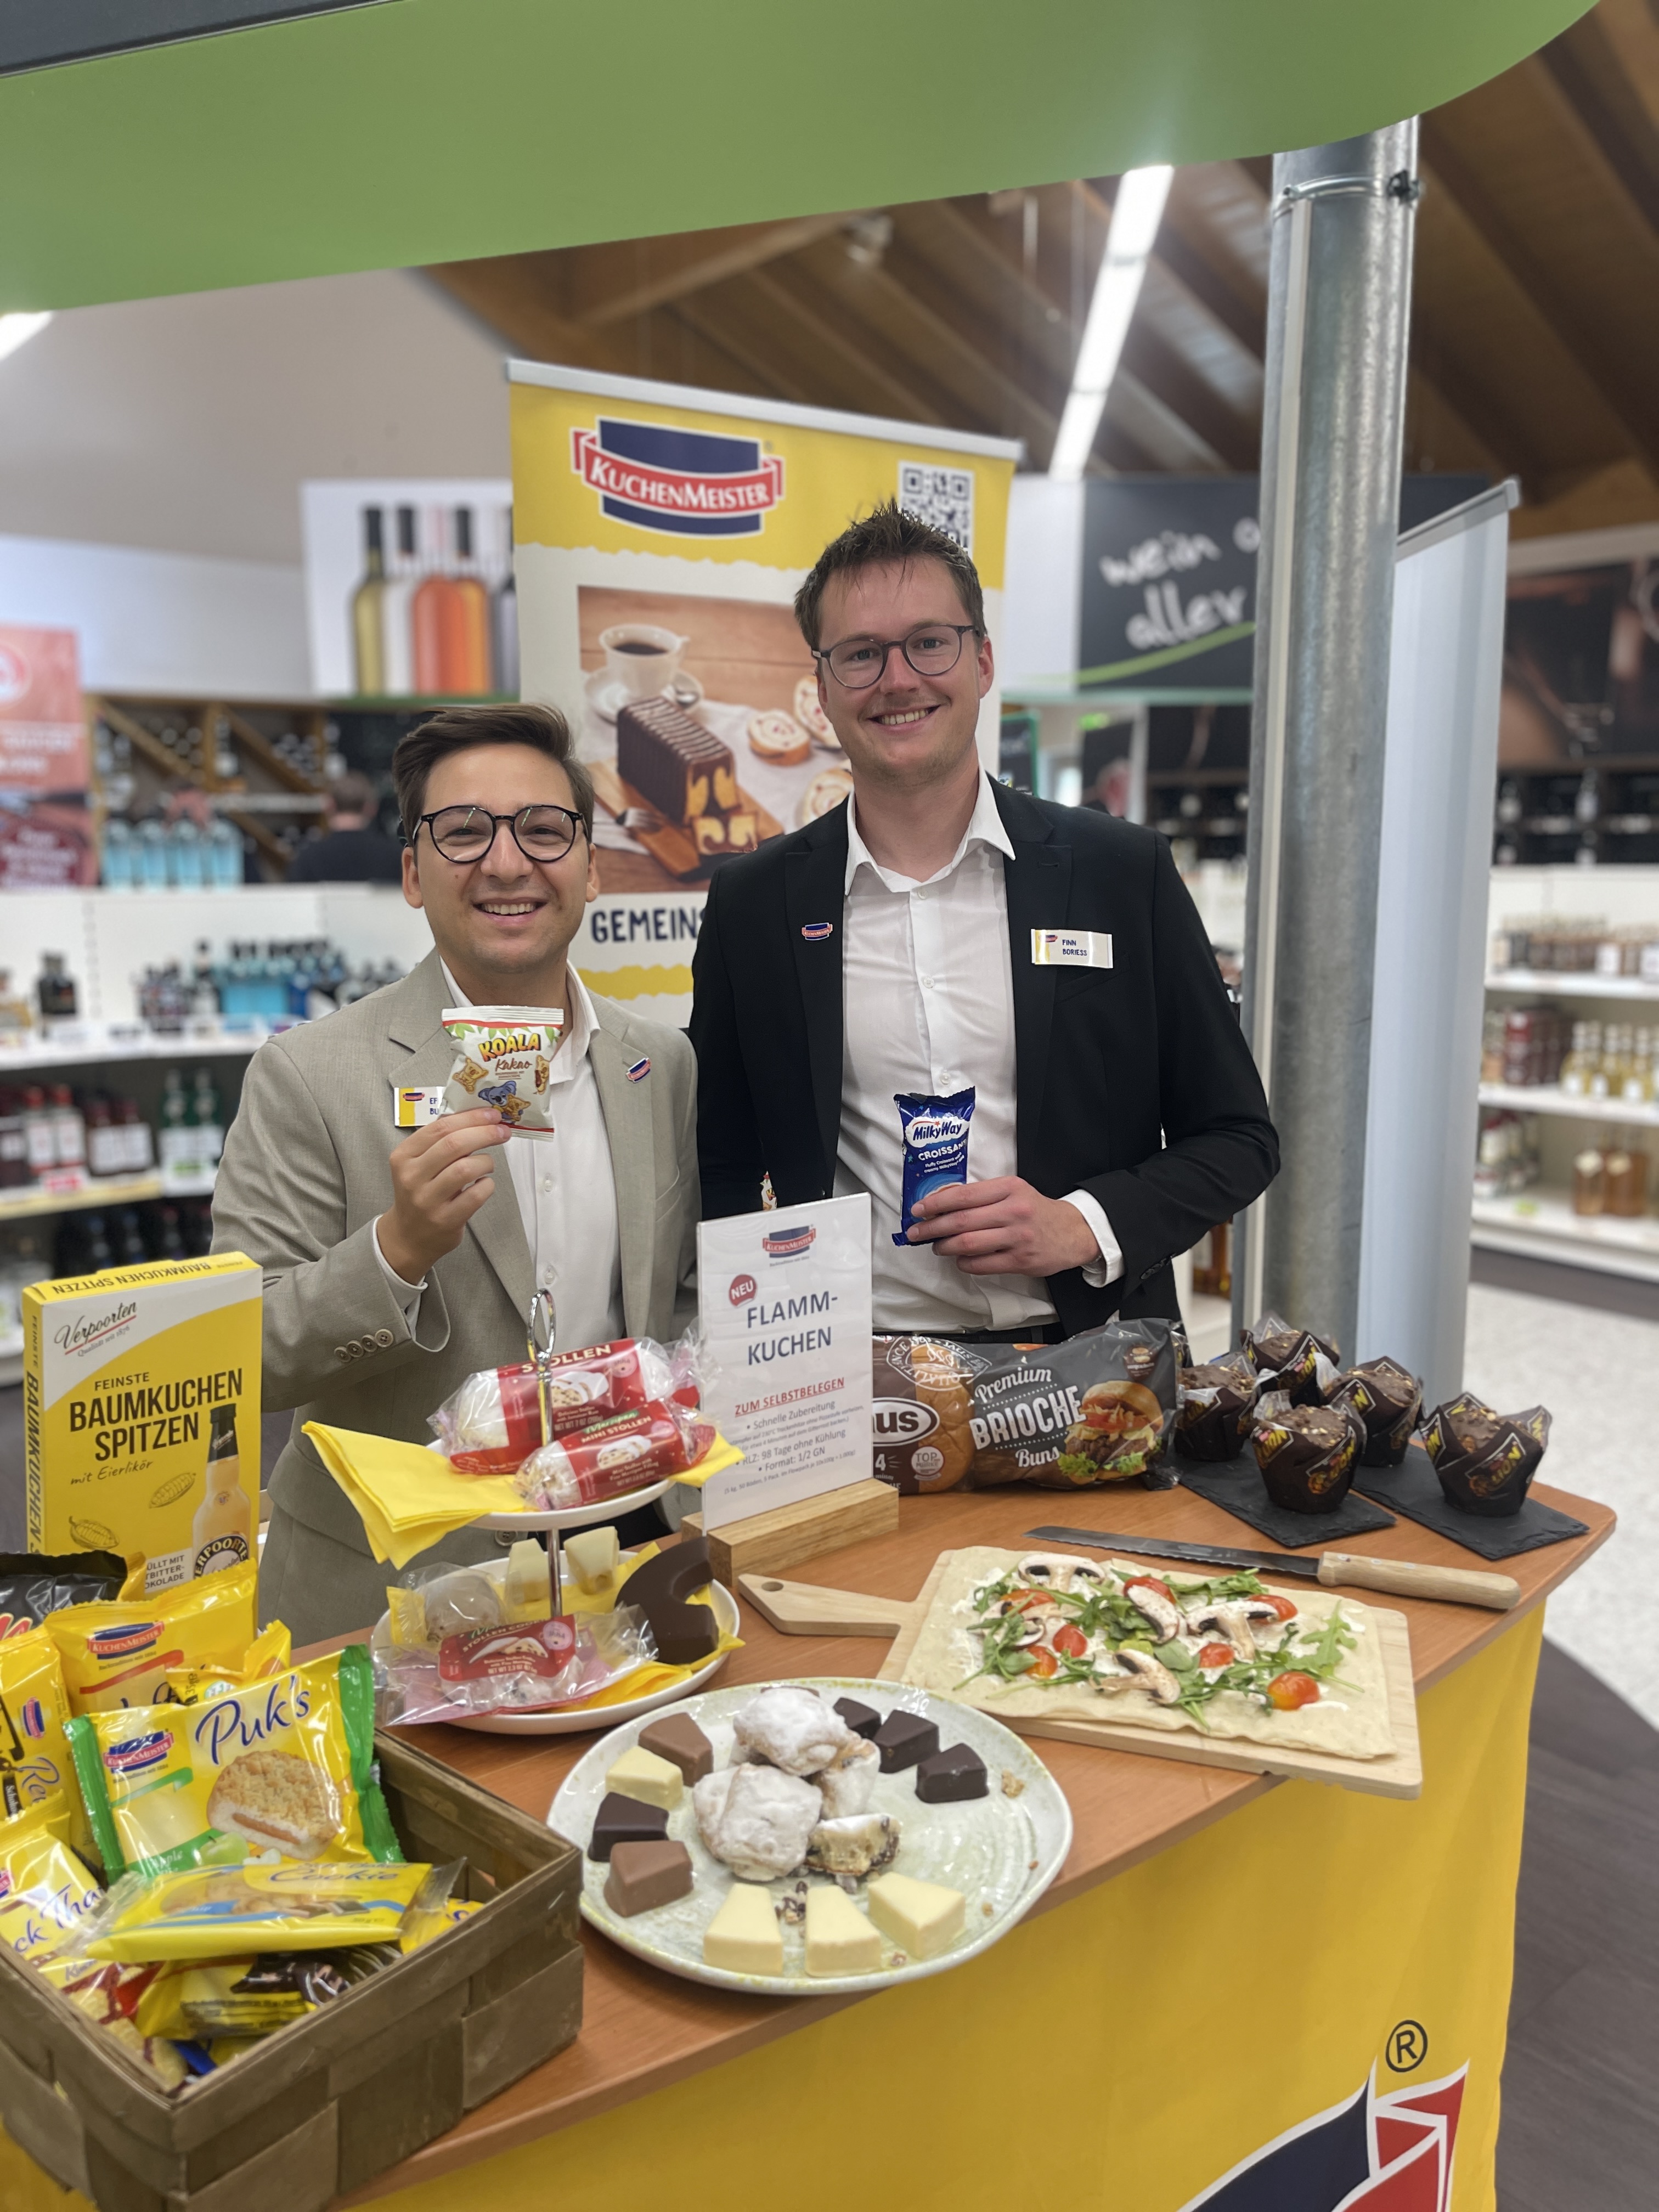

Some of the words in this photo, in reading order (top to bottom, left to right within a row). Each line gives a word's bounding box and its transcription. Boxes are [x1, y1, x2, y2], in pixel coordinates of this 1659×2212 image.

[1062, 948, 1087, 956] BORIESS
[478, 1033, 541, 1062] KOALA
[495, 1058, 533, 1072] Kakao
[52, 1278, 115, 1294] SPITZEN
[115, 1262, 211, 1284] BAUMKUCHEN
[731, 1280, 754, 1300] NEU
[747, 1290, 838, 1328] FLAMM-
[55, 1302, 137, 1350] Verpoorten
[521, 1344, 611, 1373] SOLLEN
[748, 1326, 832, 1366] KUCHEN
[94, 1372, 150, 1392] FEINSTE
[735, 1399, 760, 1415] ZUM
[763, 1377, 845, 1408] SELBSTBELEGEN
[975, 1367, 1052, 1404] Premium
[70, 1368, 242, 1432] BAUMKUCHEN
[581, 1430, 606, 1443] MINI
[607, 1415, 652, 1435] STOLLEN
[754, 1413, 787, 1430] Schnelle
[788, 1401, 836, 1421] Zubereitung
[968, 1385, 1087, 1451] BRIOCHE
[94, 1412, 199, 1462] SPITZEN
[743, 1453, 760, 1466] RLZ:
[761, 1449, 772, 1460] 98
[774, 1445, 792, 1457] Tage
[793, 1438, 813, 1451] ohne
[815, 1429, 846, 1444] Kühlung
[26, 1370, 42, 1547] BAUMKUCHEN
[765, 1456, 796, 1471] Format:
[798, 1449, 811, 1463] 1/2
[813, 1446, 826, 1457] GN
[1015, 1446, 1060, 1468] Buns
[70, 1472, 93, 1485] mit
[97, 1459, 154, 1480] Eierlikör
[145, 1564, 185, 1581] TBITTER-
[146, 1559, 167, 1571] ÜLLT
[170, 1554, 185, 1565] MIT
[194, 1537, 247, 1579] ERPOORTE
[145, 1572, 185, 1589] OKOLADE
[462, 1627, 506, 1652] STOLLEN
[195, 1674, 311, 1765] Puk's
